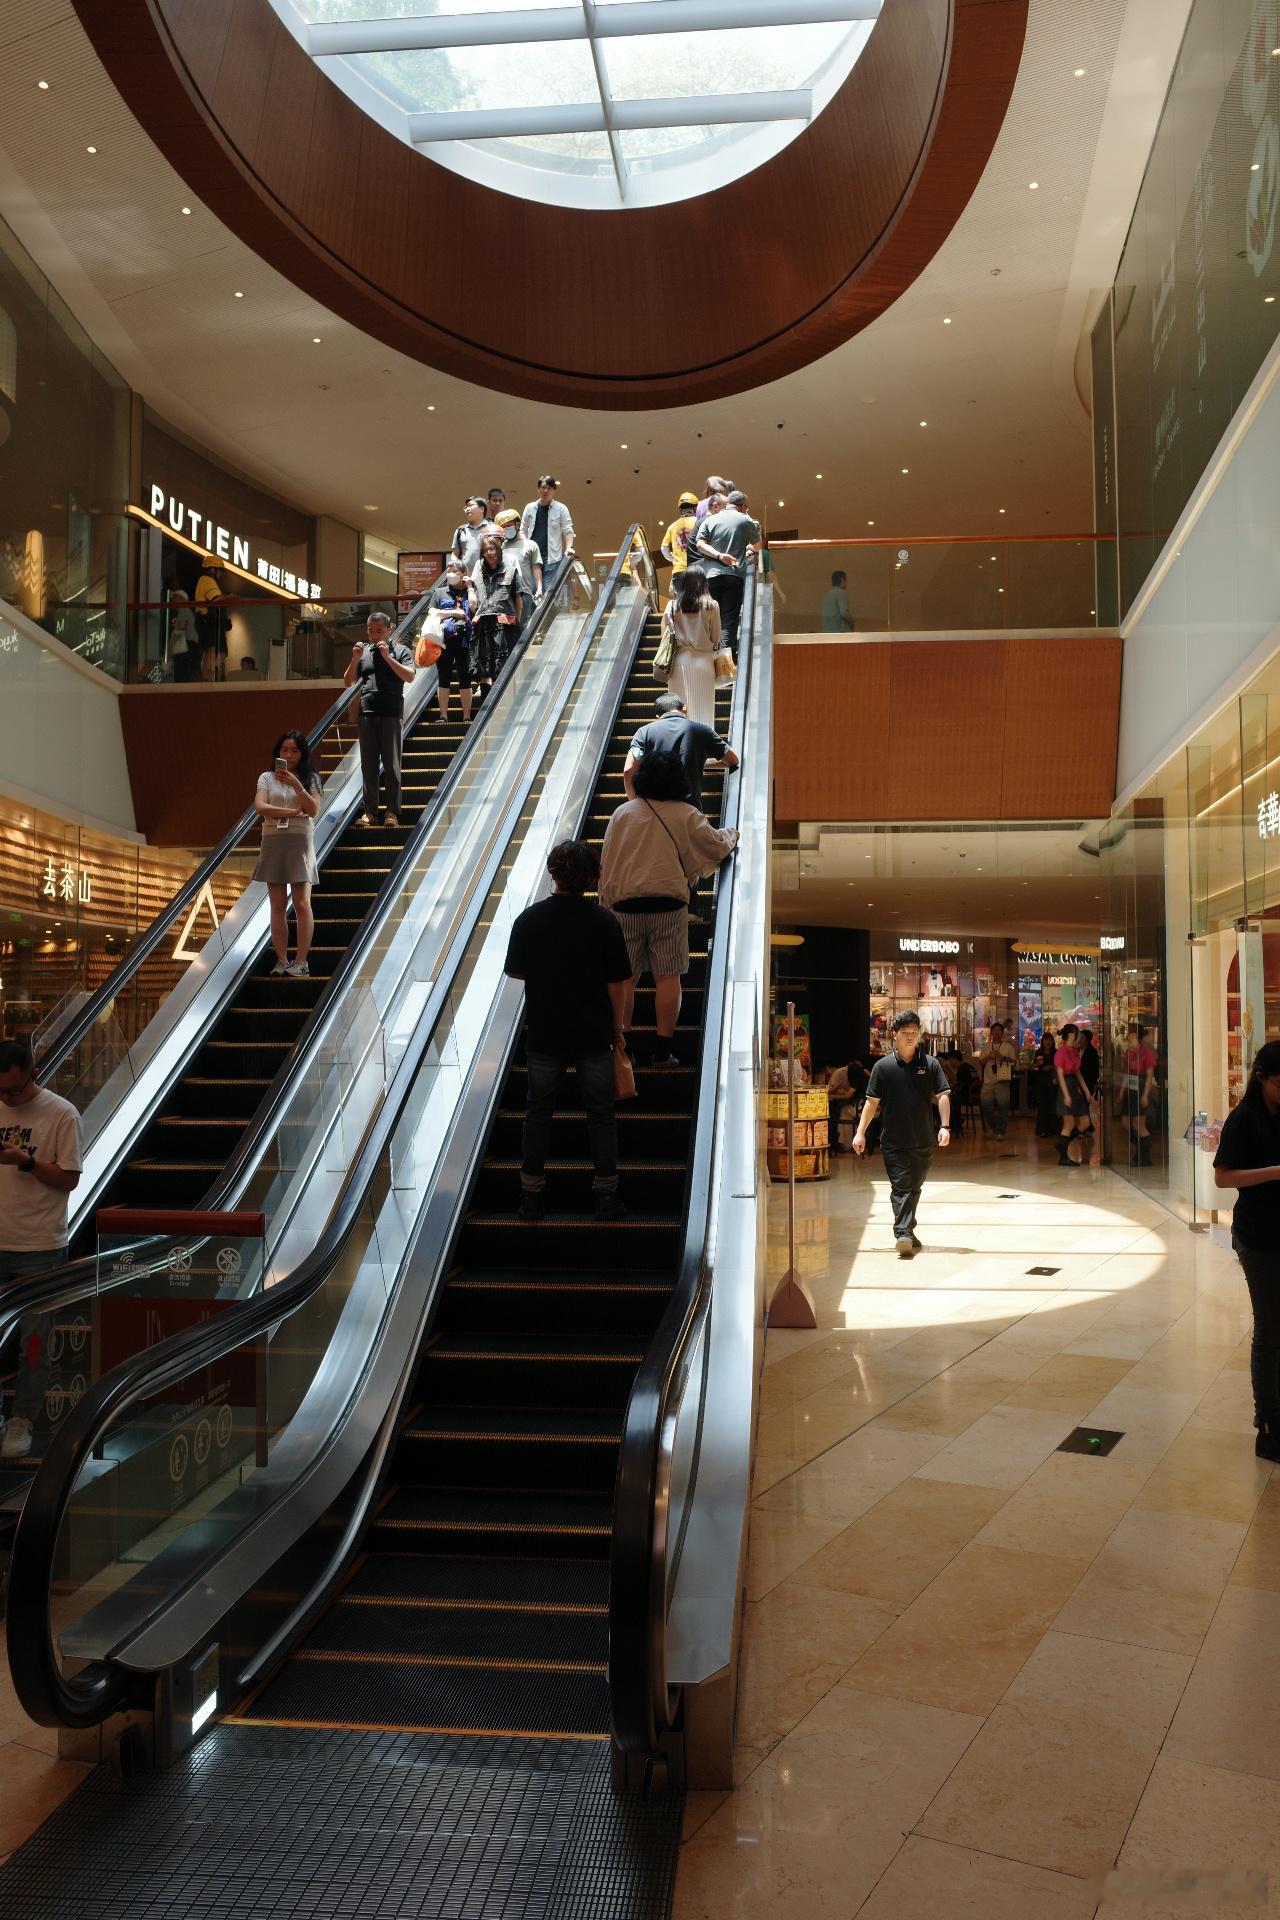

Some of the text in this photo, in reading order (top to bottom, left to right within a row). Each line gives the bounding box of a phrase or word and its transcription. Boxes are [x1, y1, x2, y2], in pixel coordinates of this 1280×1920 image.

[151, 484, 249, 570] PUTIEN
[43, 858, 91, 902] 去茶山
[899, 938, 960, 954] UNDERBOBO
[112, 1262, 131, 1272] WiFi
